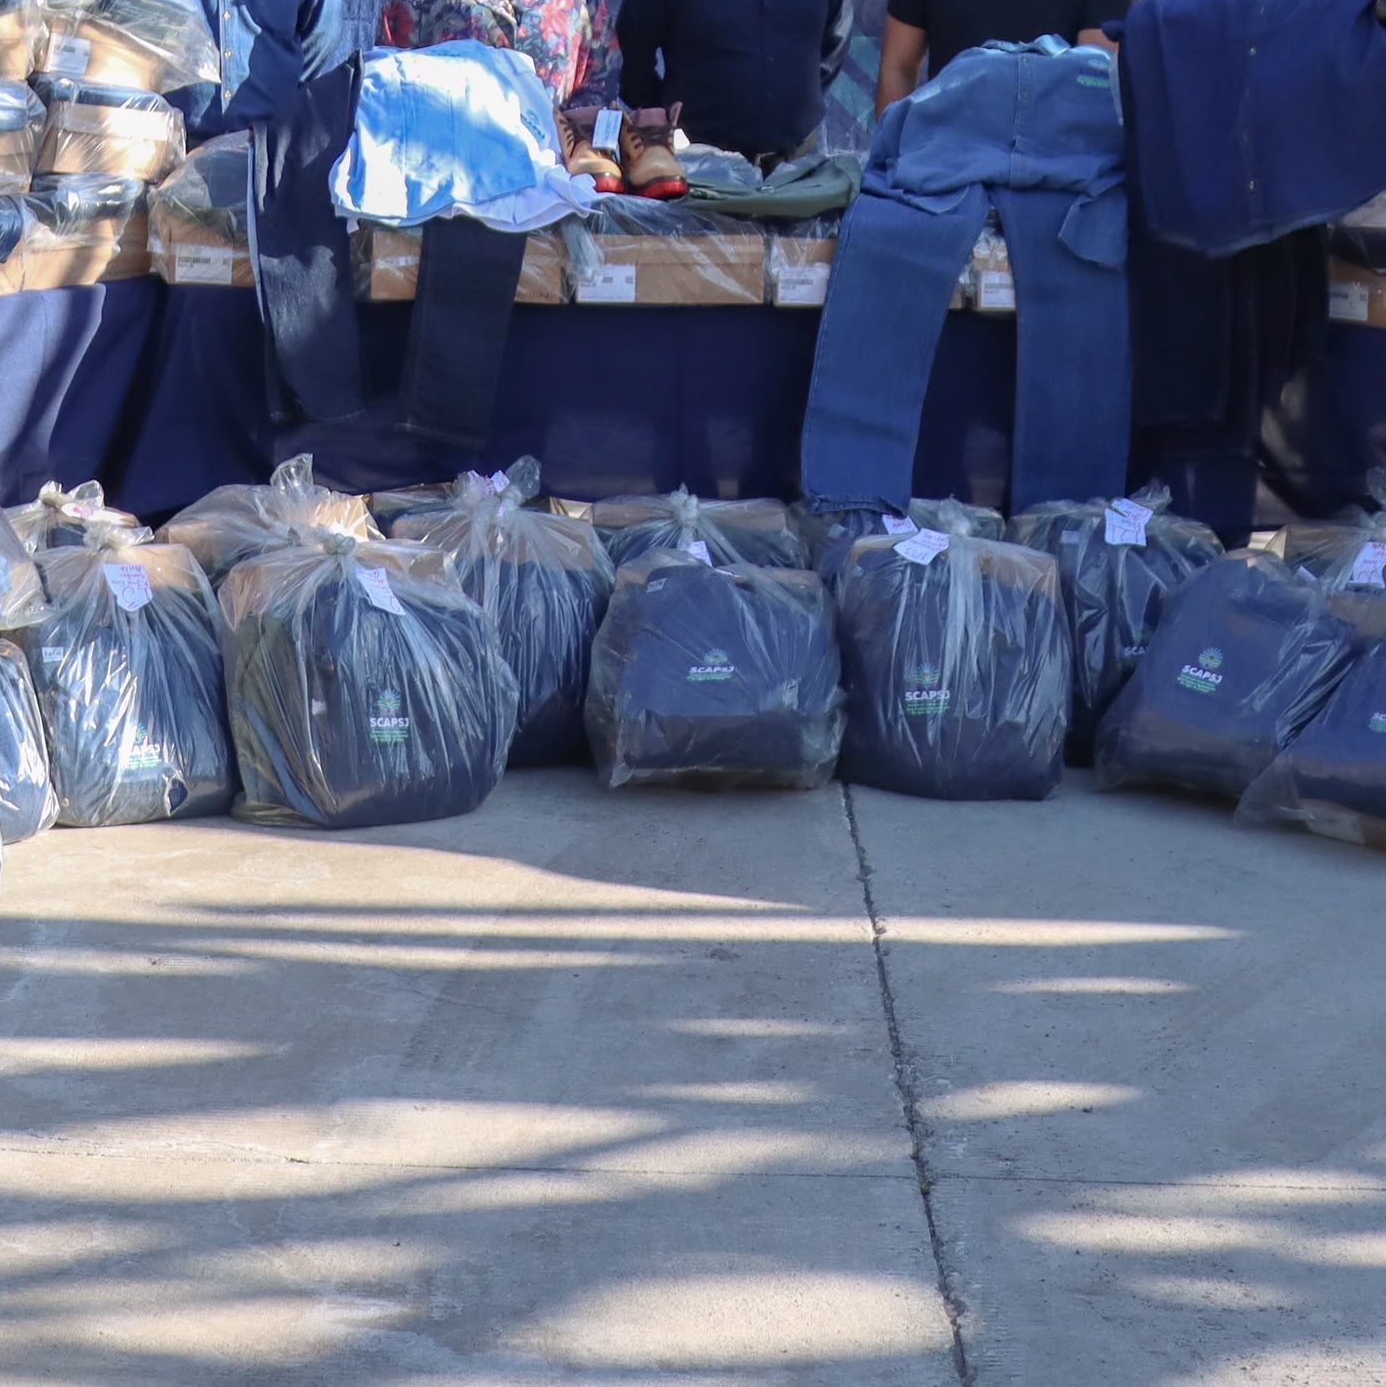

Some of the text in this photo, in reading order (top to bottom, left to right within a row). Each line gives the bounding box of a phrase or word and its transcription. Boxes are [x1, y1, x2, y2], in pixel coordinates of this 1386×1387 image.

[1182, 664, 1223, 683] SCAPSJ
[905, 690, 950, 701] SCAPSJ
[370, 717, 409, 728] SCAPSJ
